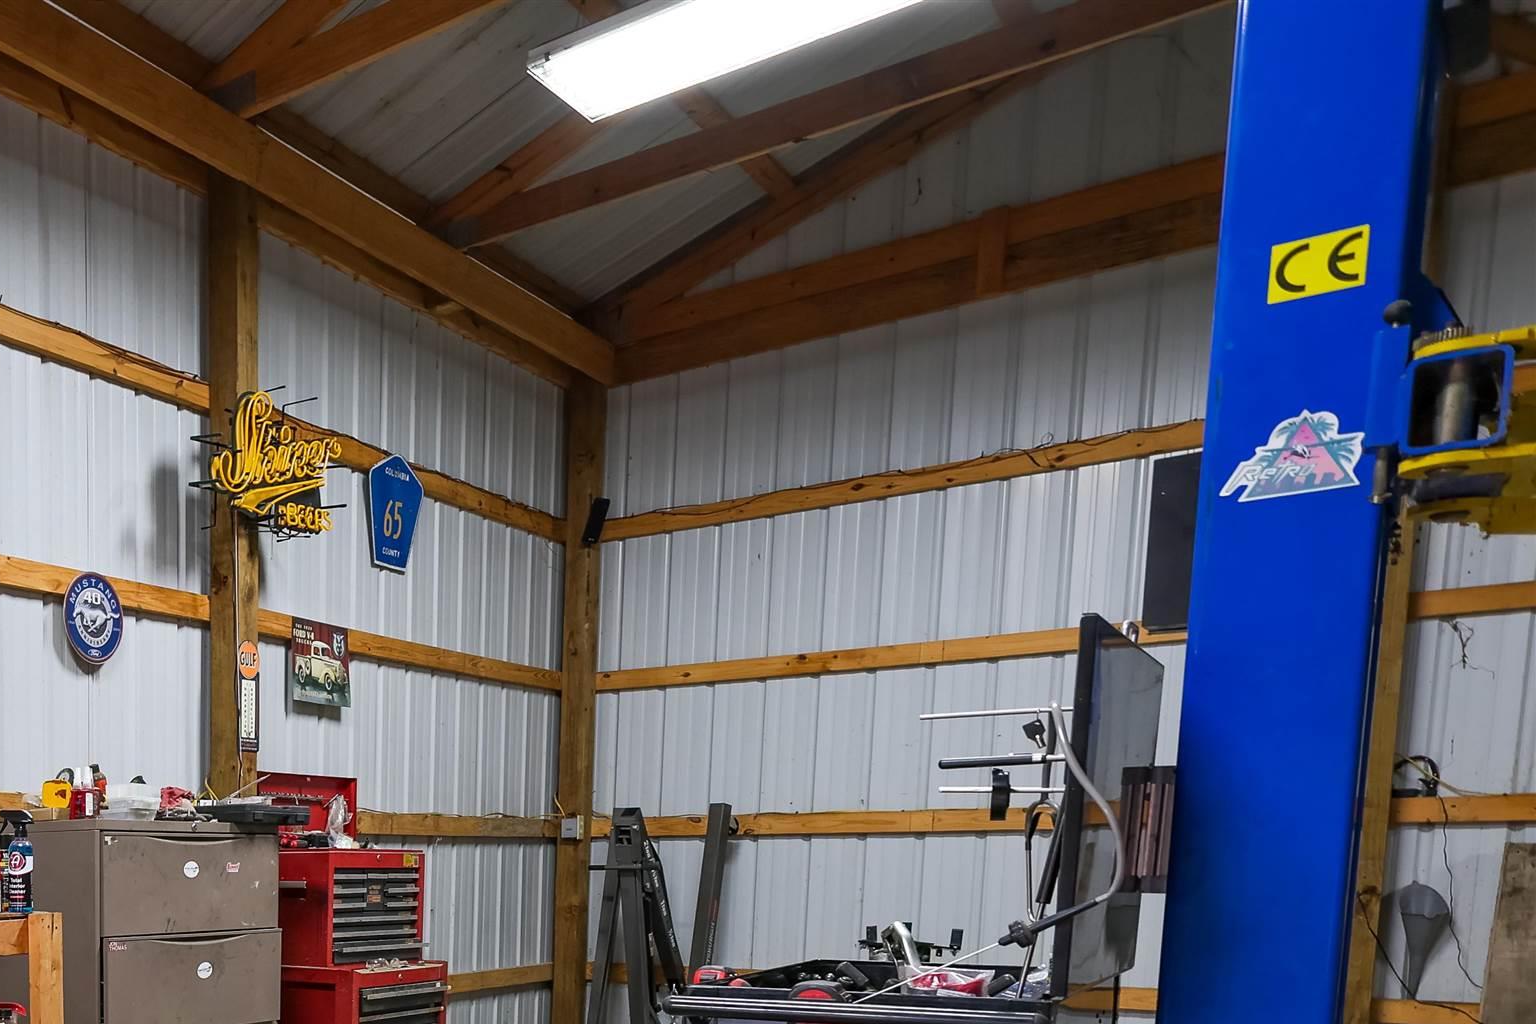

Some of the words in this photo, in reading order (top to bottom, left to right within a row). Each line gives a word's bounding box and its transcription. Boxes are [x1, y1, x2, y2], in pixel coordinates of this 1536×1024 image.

[1275, 231, 1364, 293] CE
[384, 500, 403, 539] 65
[382, 546, 400, 558] COUNTY
[69, 579, 117, 609] MUSTANG
[84, 591, 101, 605] 40
[293, 628, 306, 638] FORD
[240, 652, 256, 666] GULF
